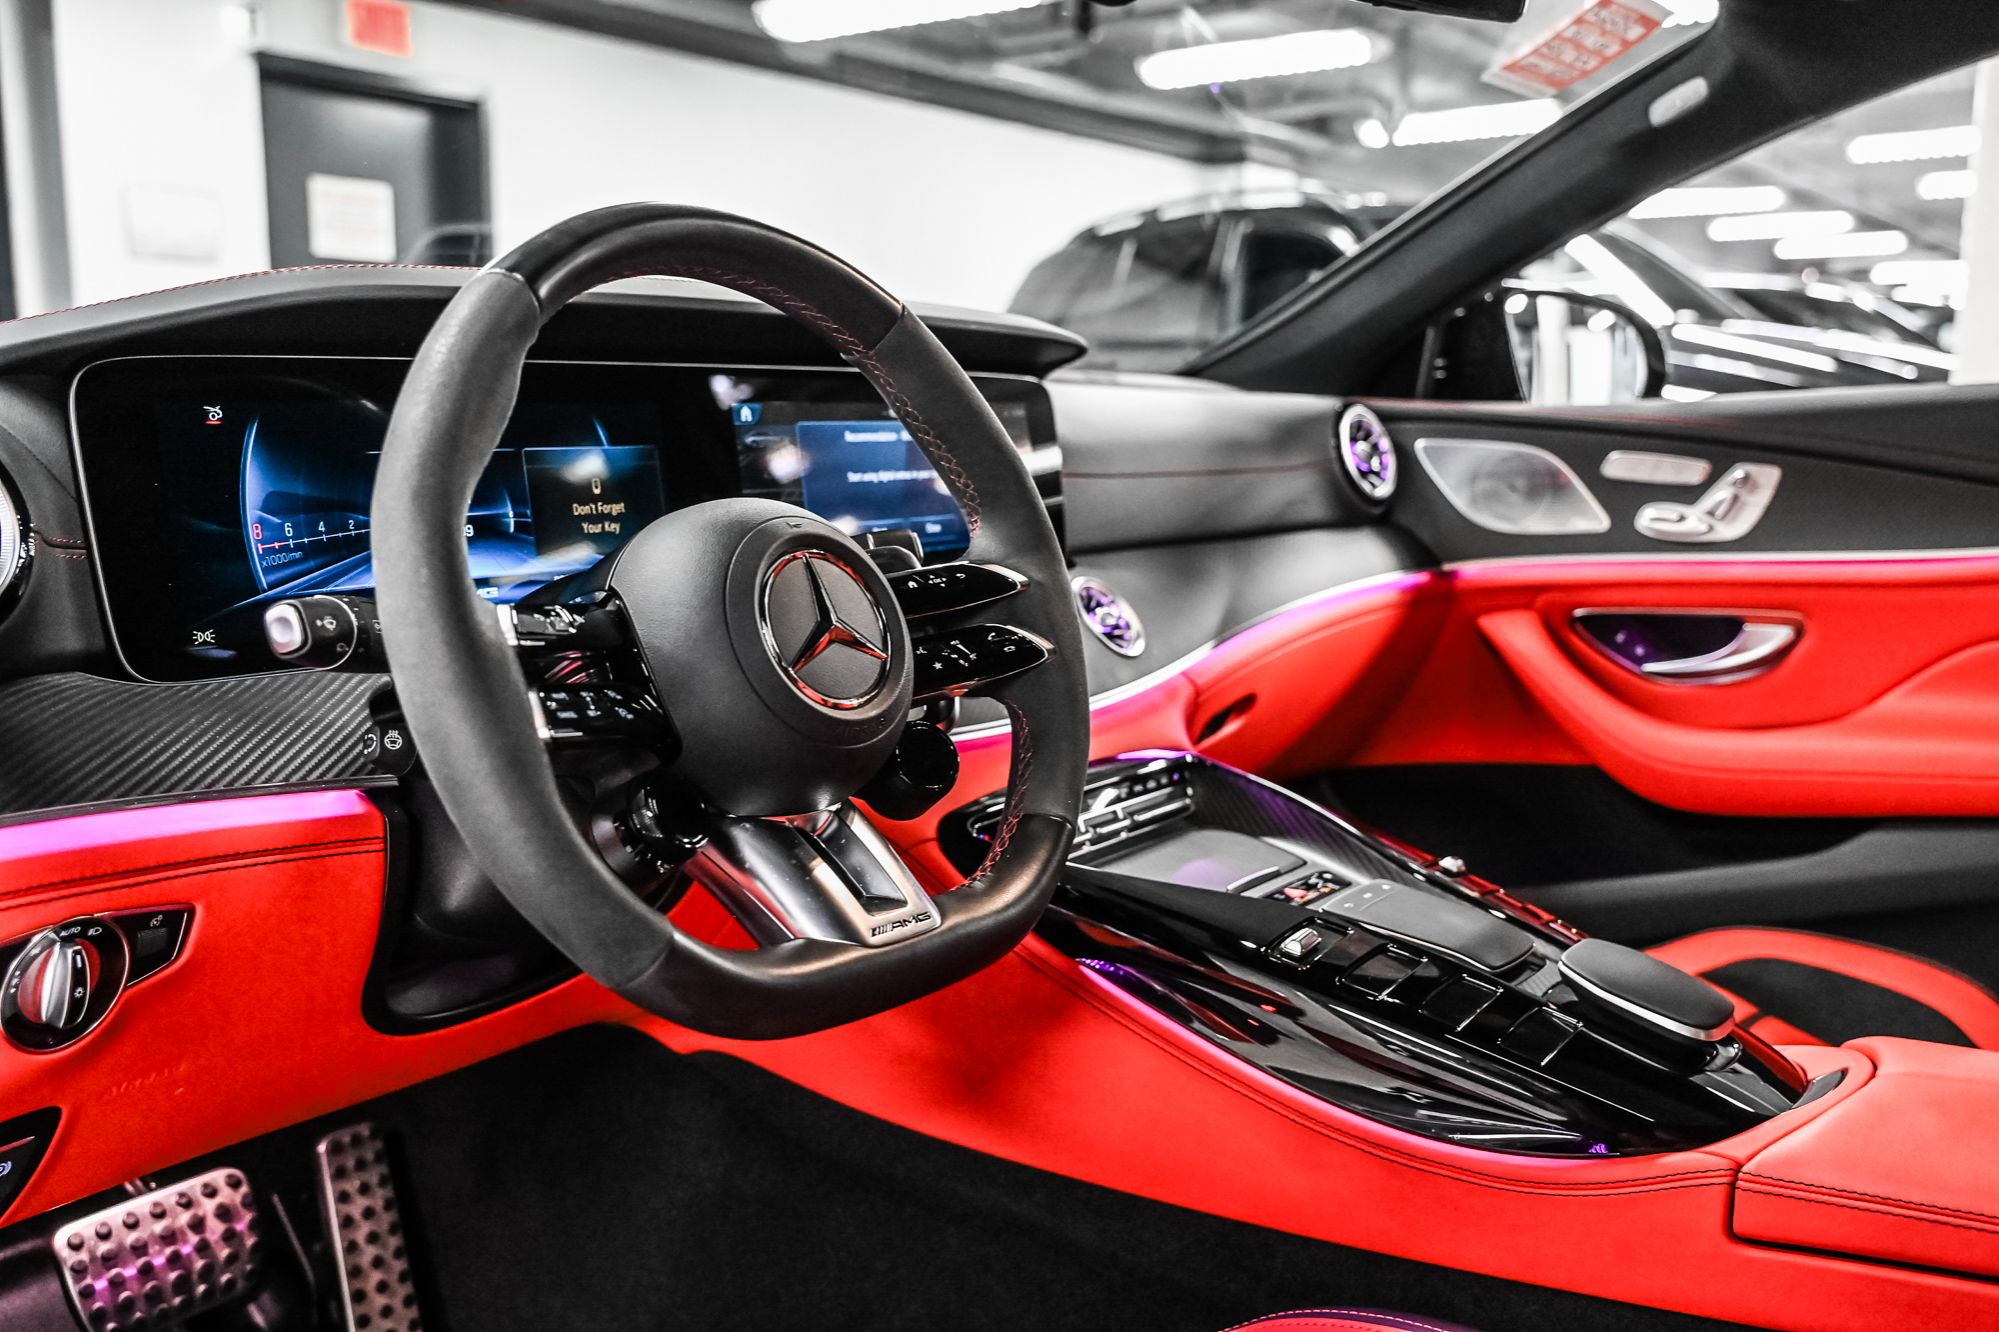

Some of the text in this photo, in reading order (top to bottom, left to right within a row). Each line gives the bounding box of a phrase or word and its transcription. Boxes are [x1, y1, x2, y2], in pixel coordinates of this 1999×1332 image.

[572, 502, 625, 516] Don't Forget
[252, 520, 355, 540] 8 6 4 2
[581, 521, 620, 534] Your Key
[261, 551, 303, 568] x1000/min
[889, 911, 932, 932] AMG
[59, 926, 81, 937] AUTO
